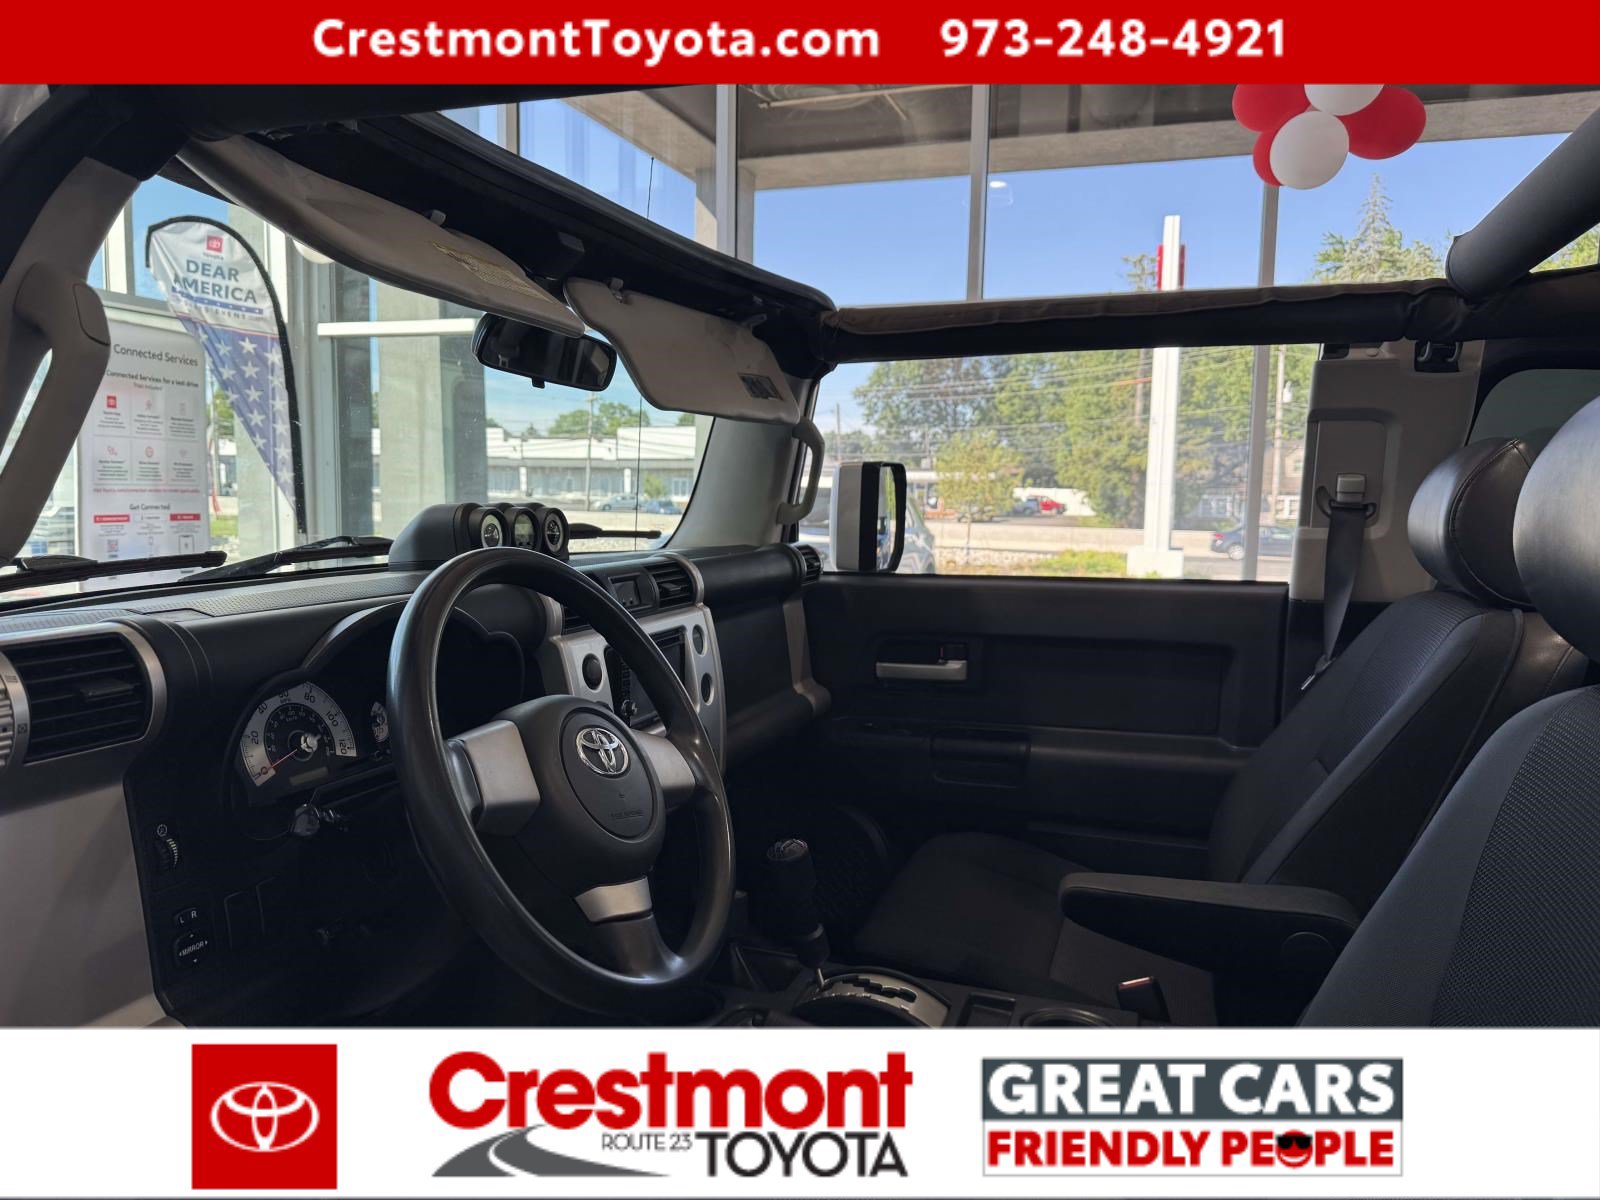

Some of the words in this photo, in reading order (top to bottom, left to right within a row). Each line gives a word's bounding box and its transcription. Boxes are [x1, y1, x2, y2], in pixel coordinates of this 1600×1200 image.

[186, 259, 240, 282] DEAR
[173, 272, 258, 305] AMERICA
[113, 343, 163, 360] Connected
[164, 352, 199, 366] Services
[106, 369, 139, 380] Connected
[139, 373, 162, 383] Services
[303, 692, 316, 704] 80
[326, 710, 339, 727] 100
[250, 730, 259, 745] 20
[339, 738, 348, 755] 120
[191, 910, 197, 919] R
[181, 940, 204, 956] MIRROR
